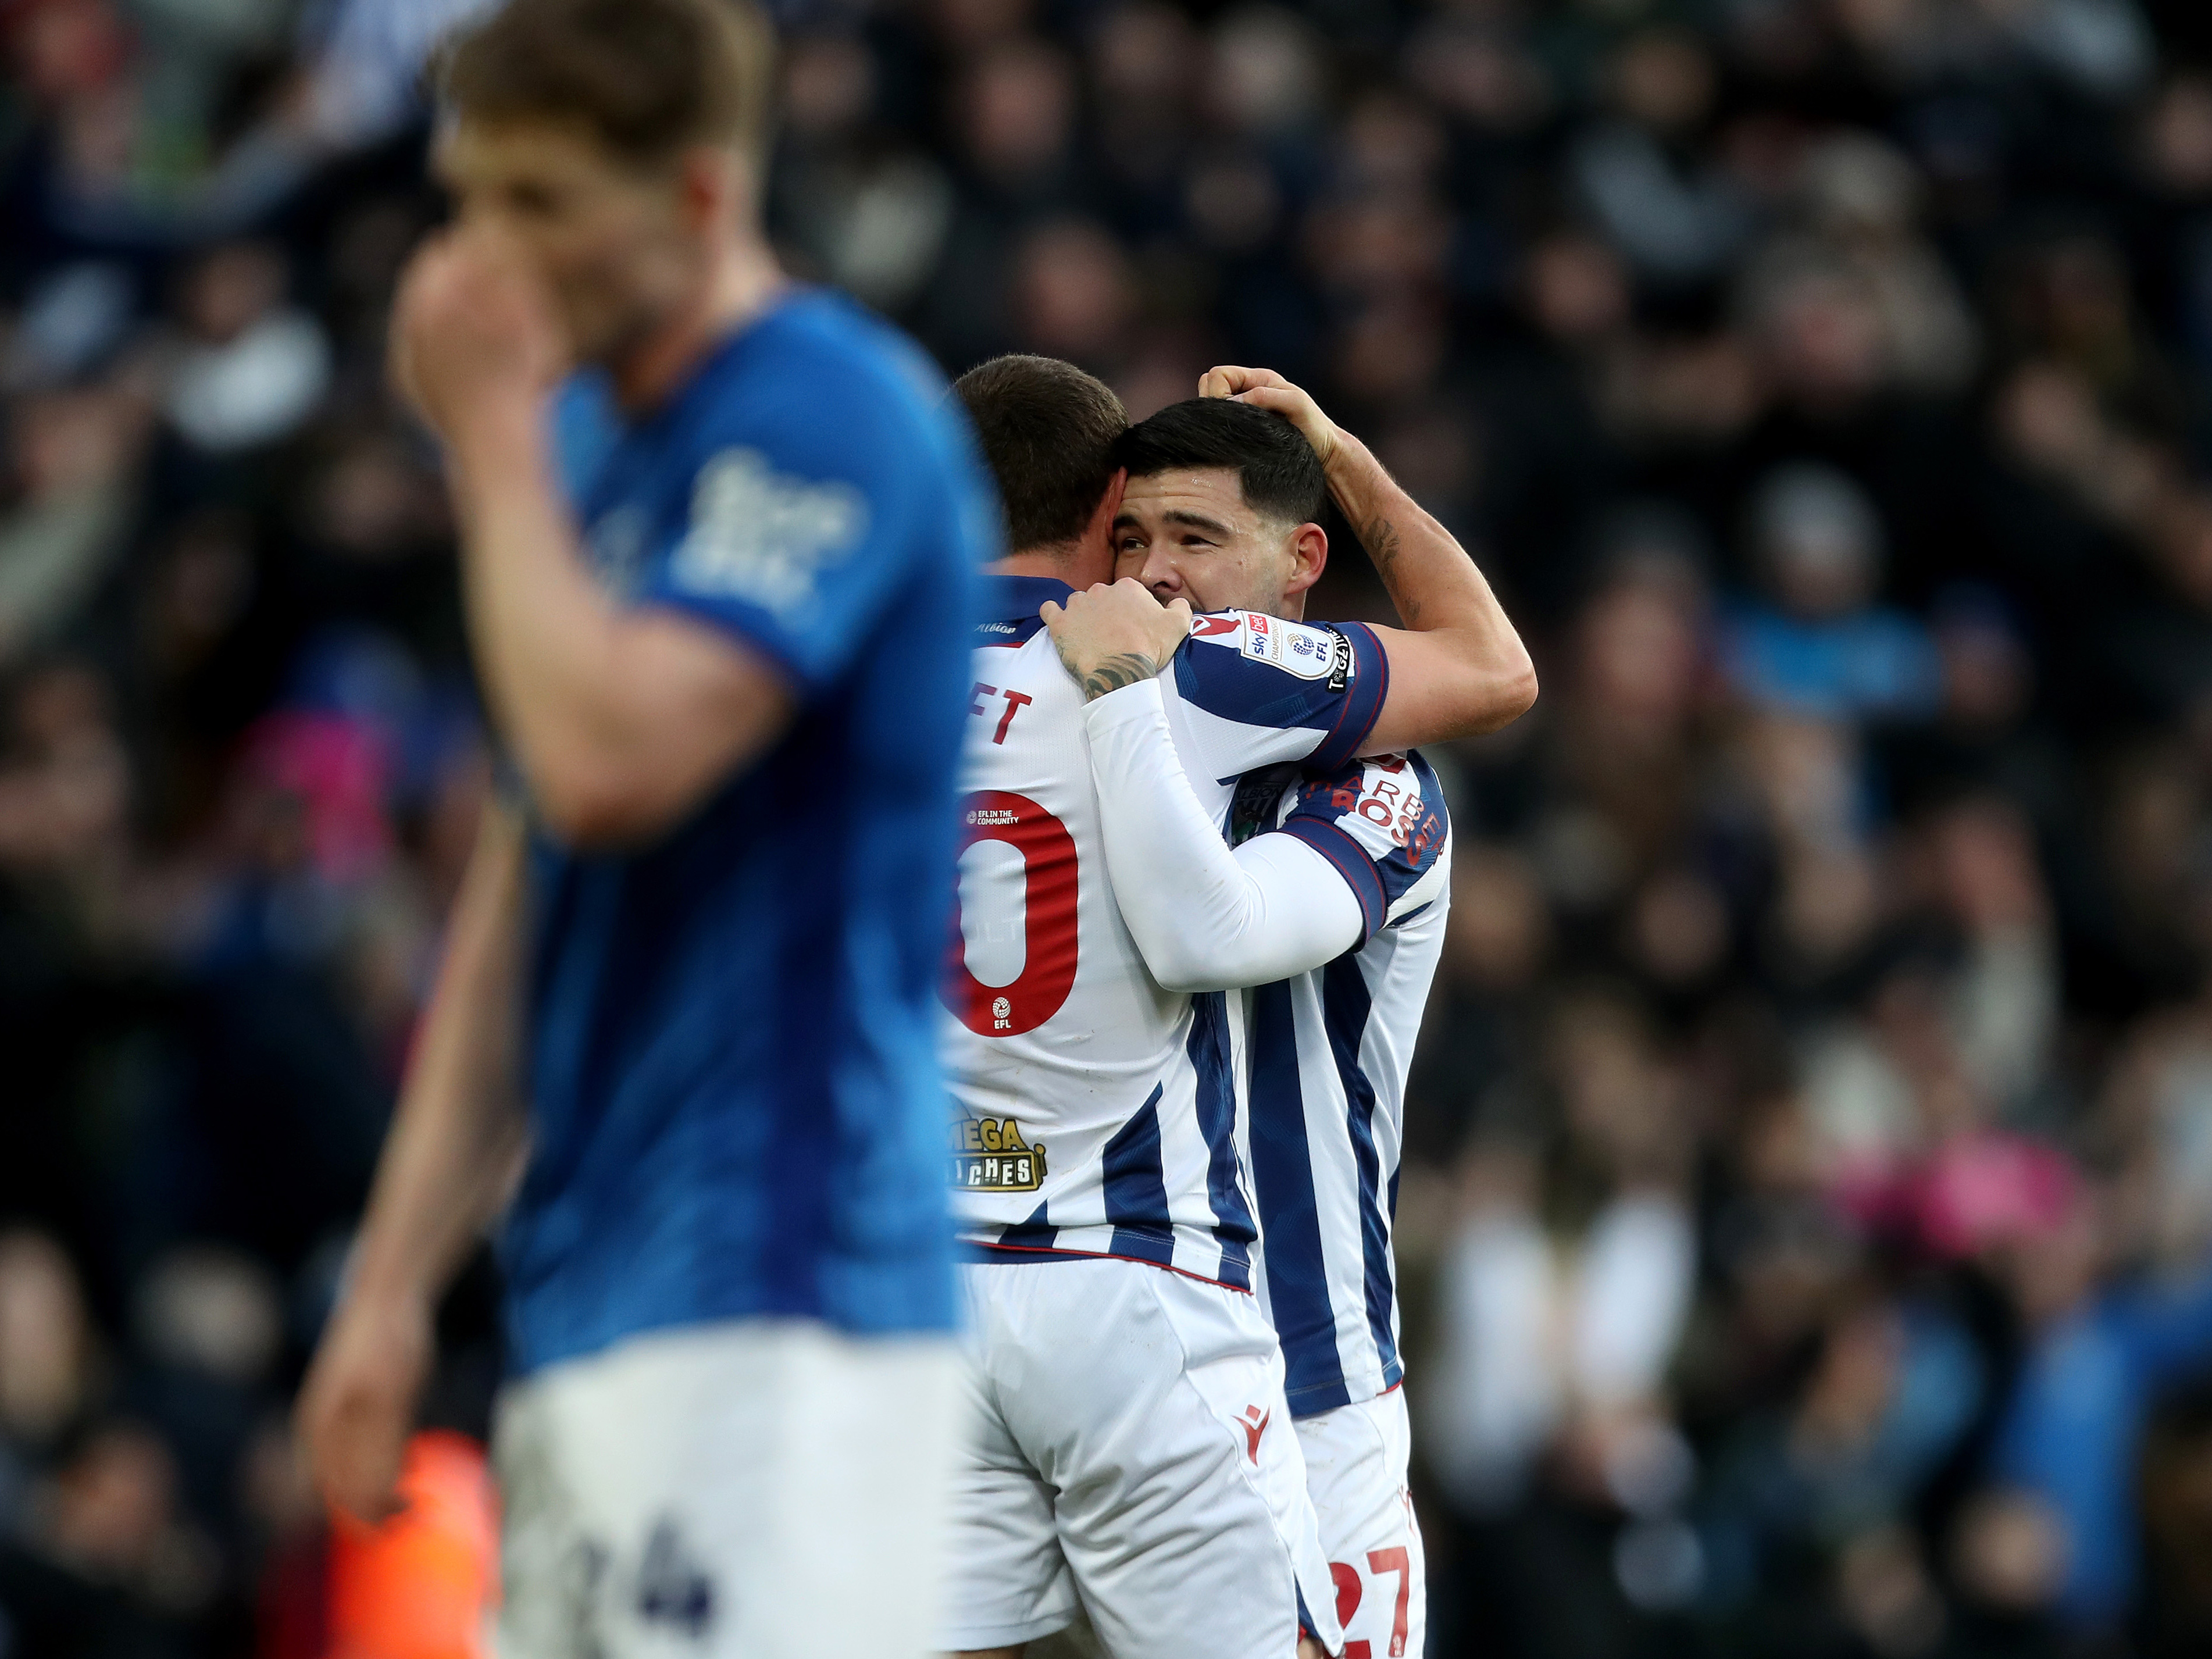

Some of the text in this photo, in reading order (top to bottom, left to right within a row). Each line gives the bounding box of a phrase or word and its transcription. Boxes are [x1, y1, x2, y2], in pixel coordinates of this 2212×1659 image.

[974, 622, 1016, 634] Albion
[1251, 615, 1268, 655] sky bet
[1315, 641, 1328, 662] EFL
[969, 682, 1033, 745] FT
[977, 816, 1019, 825] COMMUNITY
[1330, 789, 1428, 866] ROSS
[994, 1019, 1011, 1029] EFL
